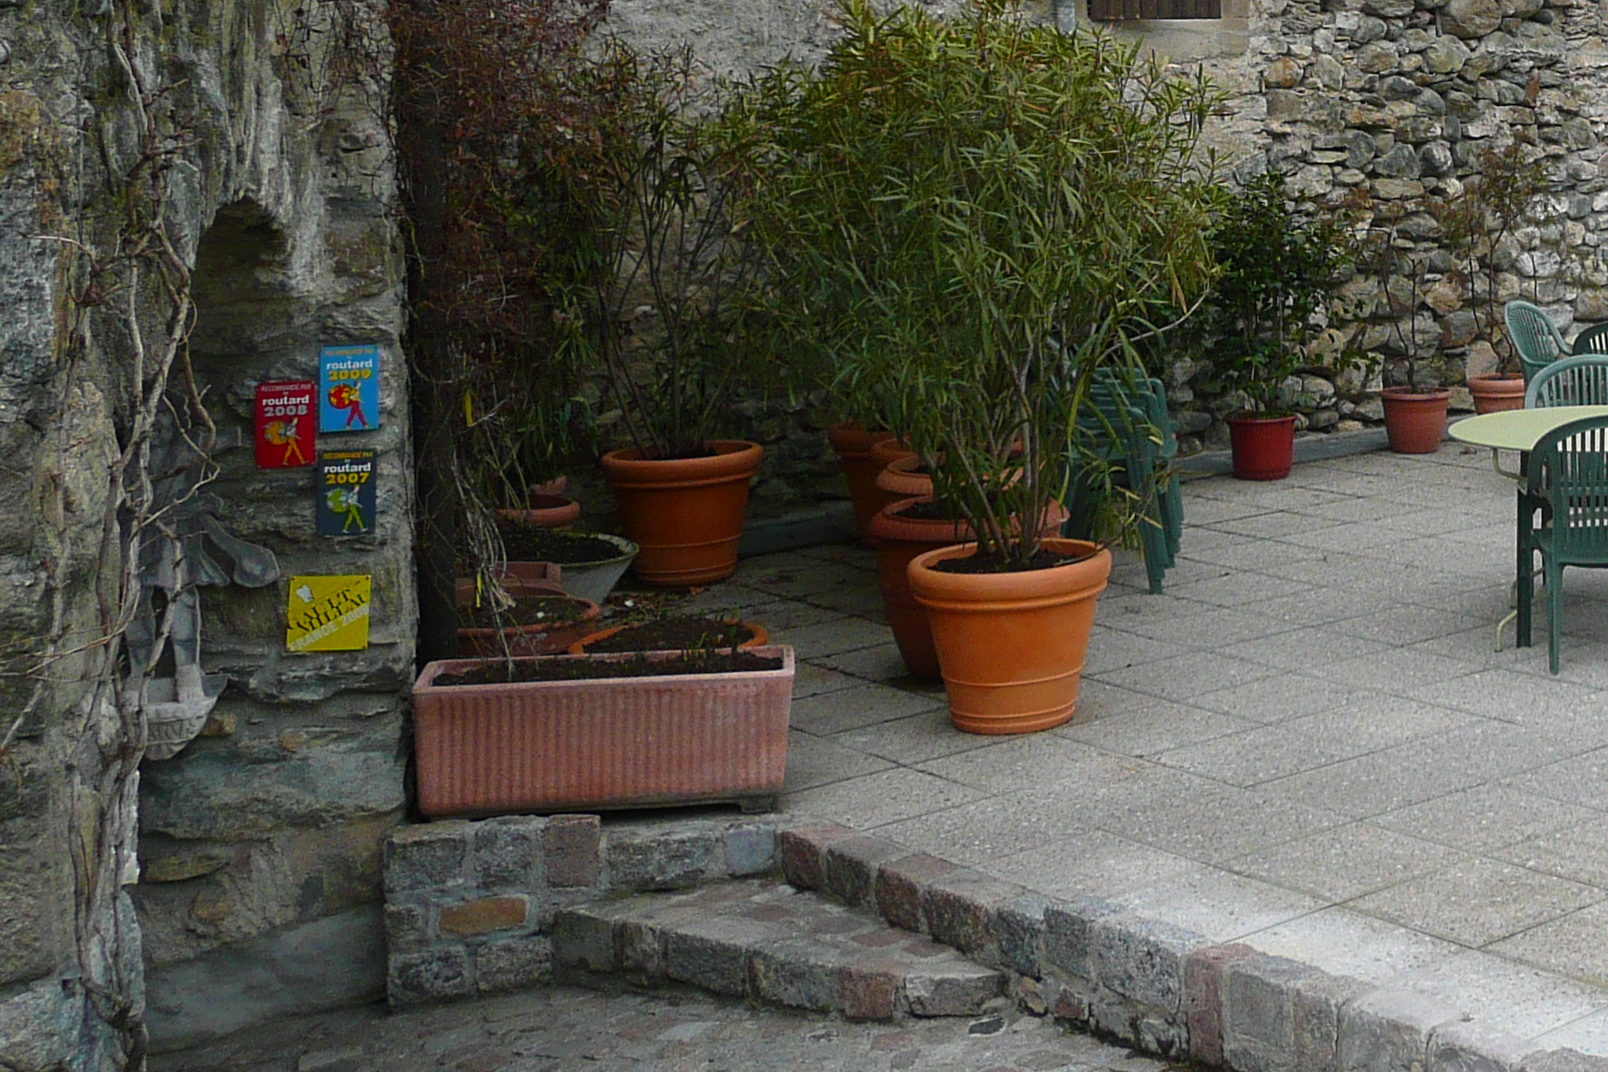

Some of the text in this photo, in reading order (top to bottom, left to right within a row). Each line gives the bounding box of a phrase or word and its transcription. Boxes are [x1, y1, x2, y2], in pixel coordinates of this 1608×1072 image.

[326, 358, 373, 370] routard
[328, 368, 372, 381] 2009
[262, 394, 310, 406] routard
[264, 405, 308, 417] 2008
[324, 462, 372, 473] routard
[325, 472, 371, 485] 2007
